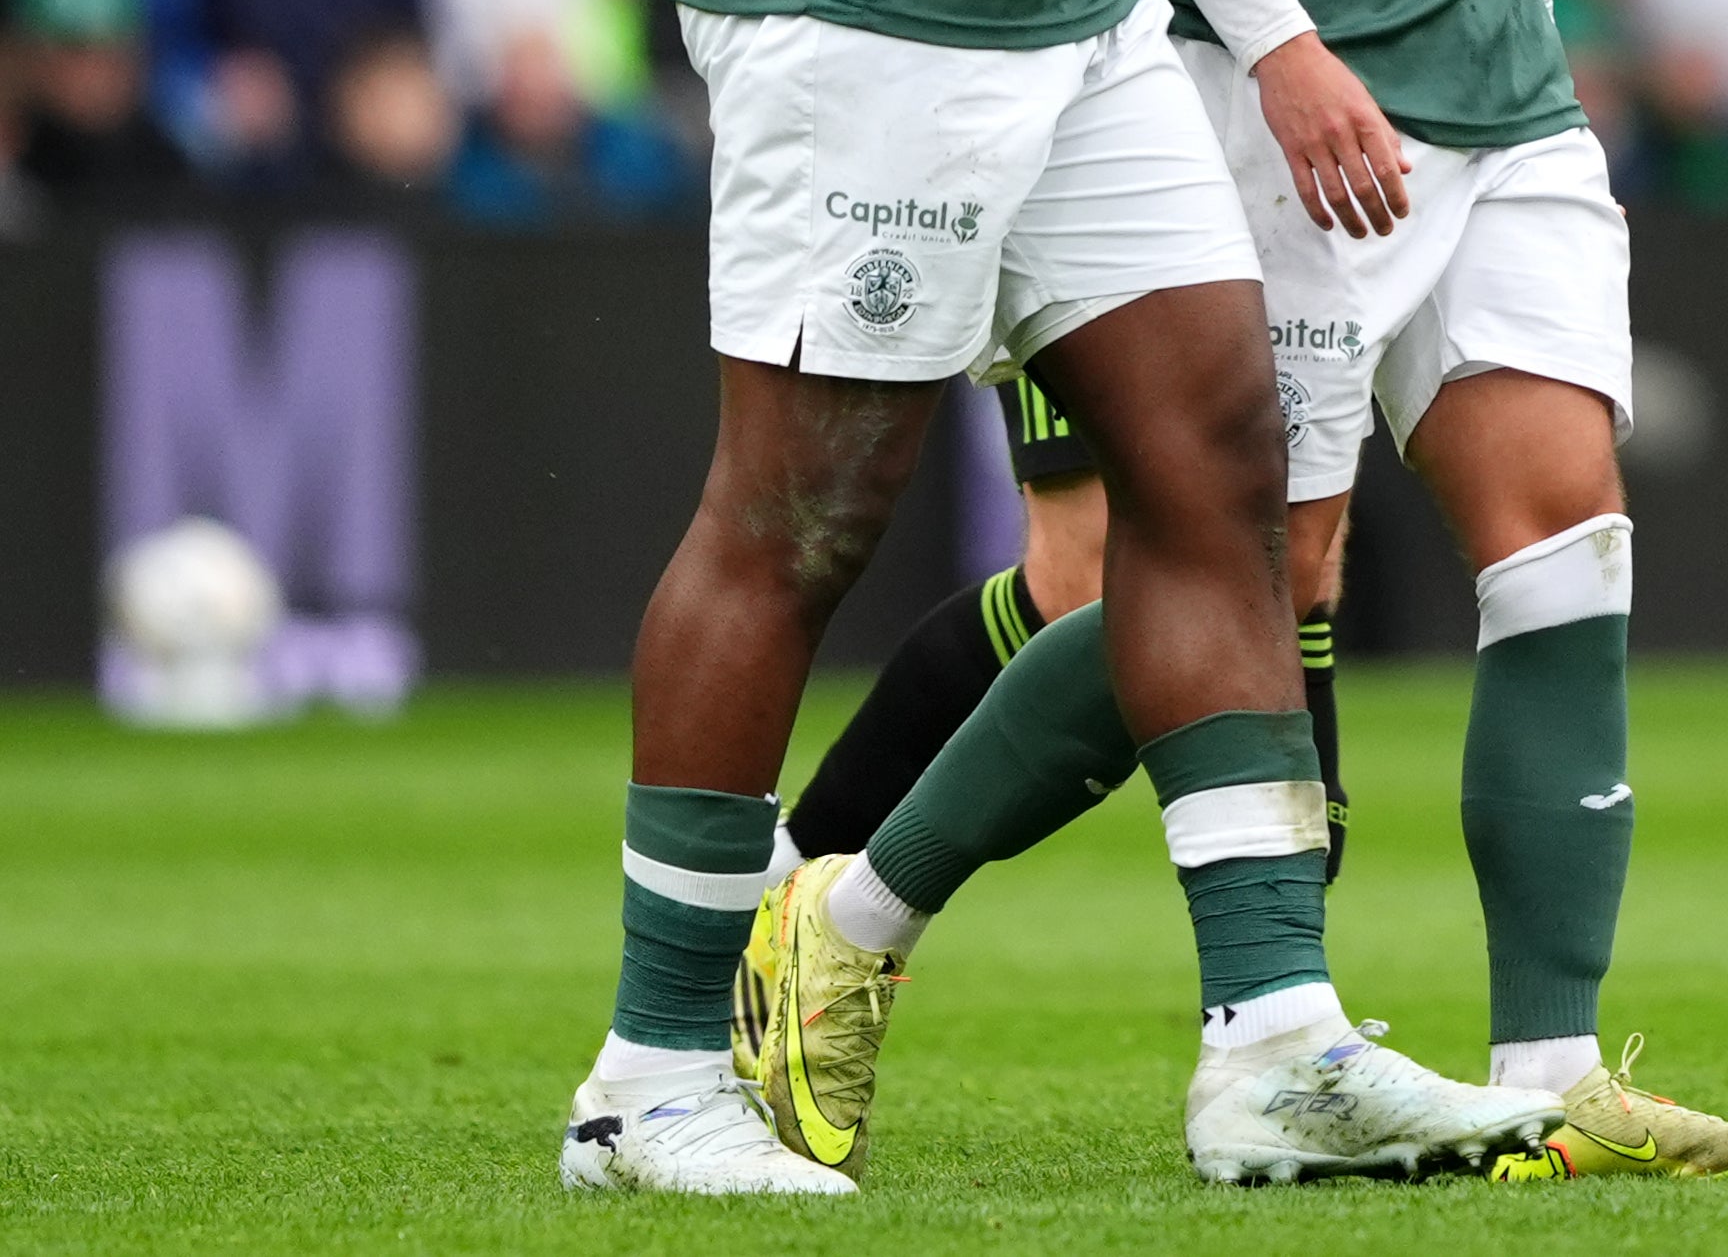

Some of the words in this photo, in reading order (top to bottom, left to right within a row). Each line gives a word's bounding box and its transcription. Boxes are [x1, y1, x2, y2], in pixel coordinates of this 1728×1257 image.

[825, 190, 948, 237] Capital
[882, 231, 917, 241] Credit
[921, 234, 952, 243] Union
